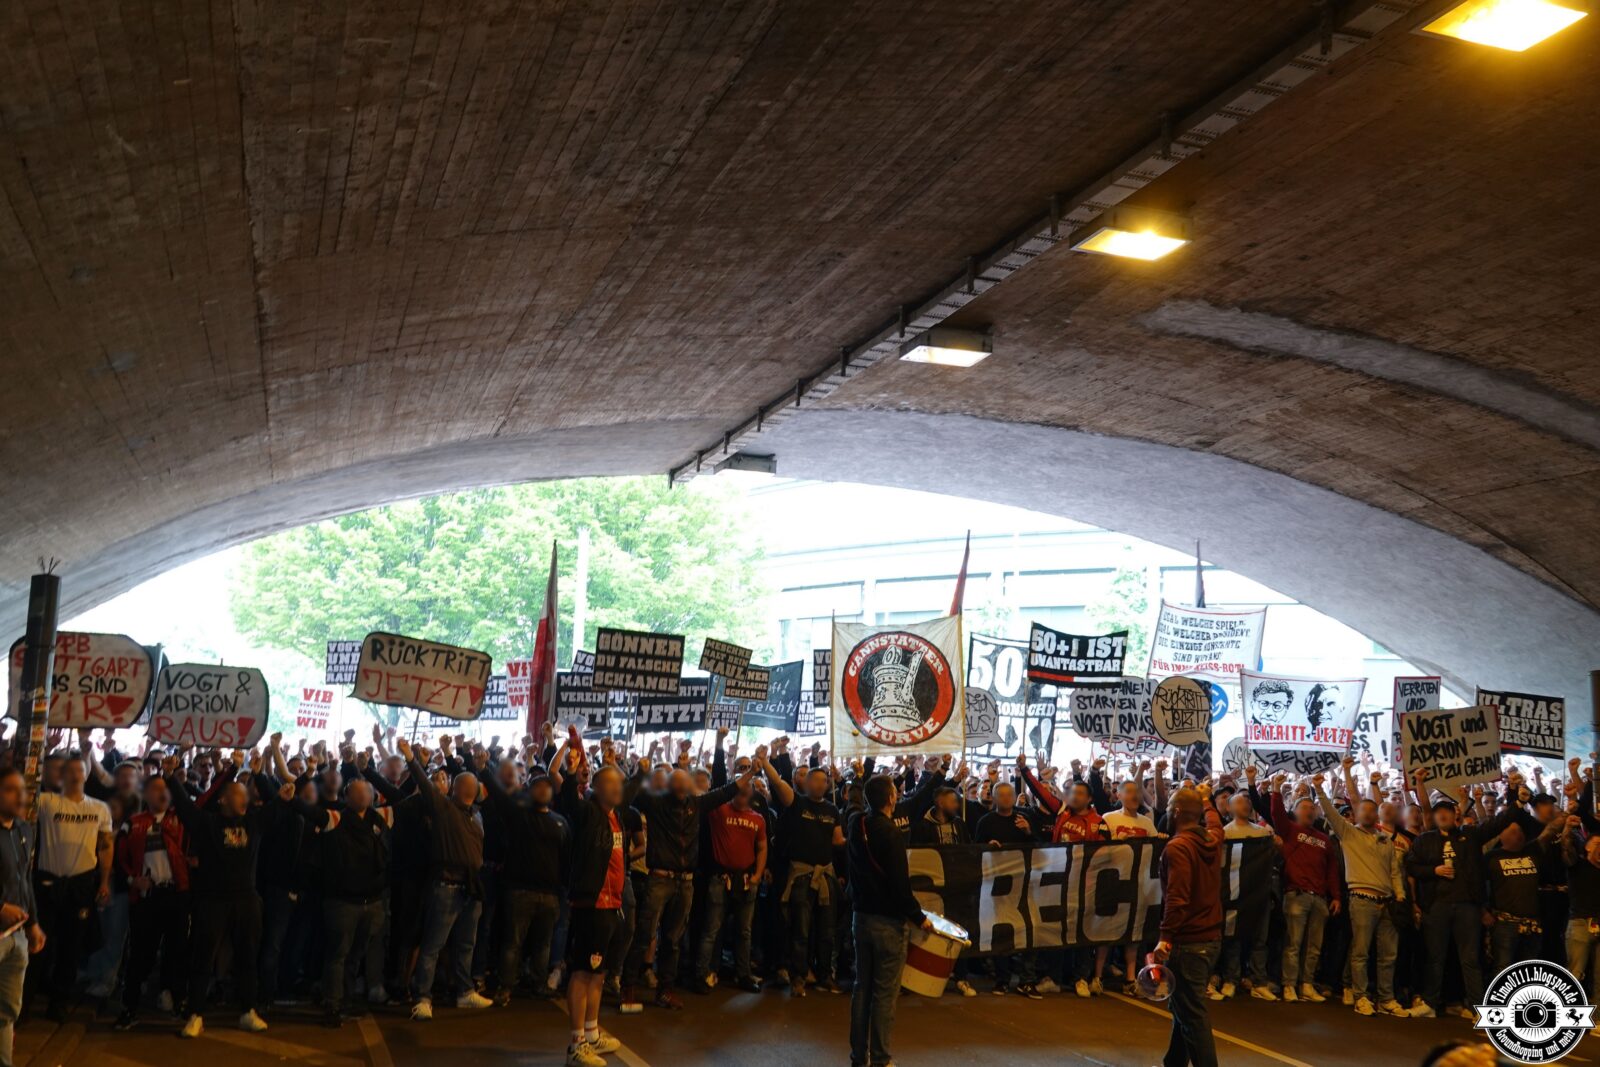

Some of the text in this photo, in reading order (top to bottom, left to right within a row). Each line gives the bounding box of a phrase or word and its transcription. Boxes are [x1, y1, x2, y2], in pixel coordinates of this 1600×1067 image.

[1173, 627, 1211, 640] WELCHER
[848, 634, 944, 677] CANNSTATTER
[1086, 637, 1128, 658] IST
[1170, 639, 1203, 651] EINZIGE
[327, 652, 361, 665] UND
[618, 656, 680, 673] FALSCHE
[1153, 659, 1170, 671] FÜR
[1173, 652, 1193, 662] SIND
[701, 656, 745, 680] MAUL
[163, 669, 252, 692] VOGT &
[593, 670, 679, 692] SCHLANGE
[1398, 681, 1439, 698] VERRATEN
[362, 668, 484, 715] JETZT!
[560, 691, 607, 702] VEREIN
[725, 688, 767, 700] SCHLANGE
[636, 703, 705, 725] JETZT
[1405, 698, 1427, 712] UND
[155, 715, 256, 746] RAUS!
[297, 716, 327, 729] WIR
[863, 717, 940, 744] KURVE
[1075, 713, 1114, 735] VOGT
[1407, 713, 1455, 741] VOGT
[1461, 710, 1488, 733] und
[1409, 736, 1468, 766] ADRION
